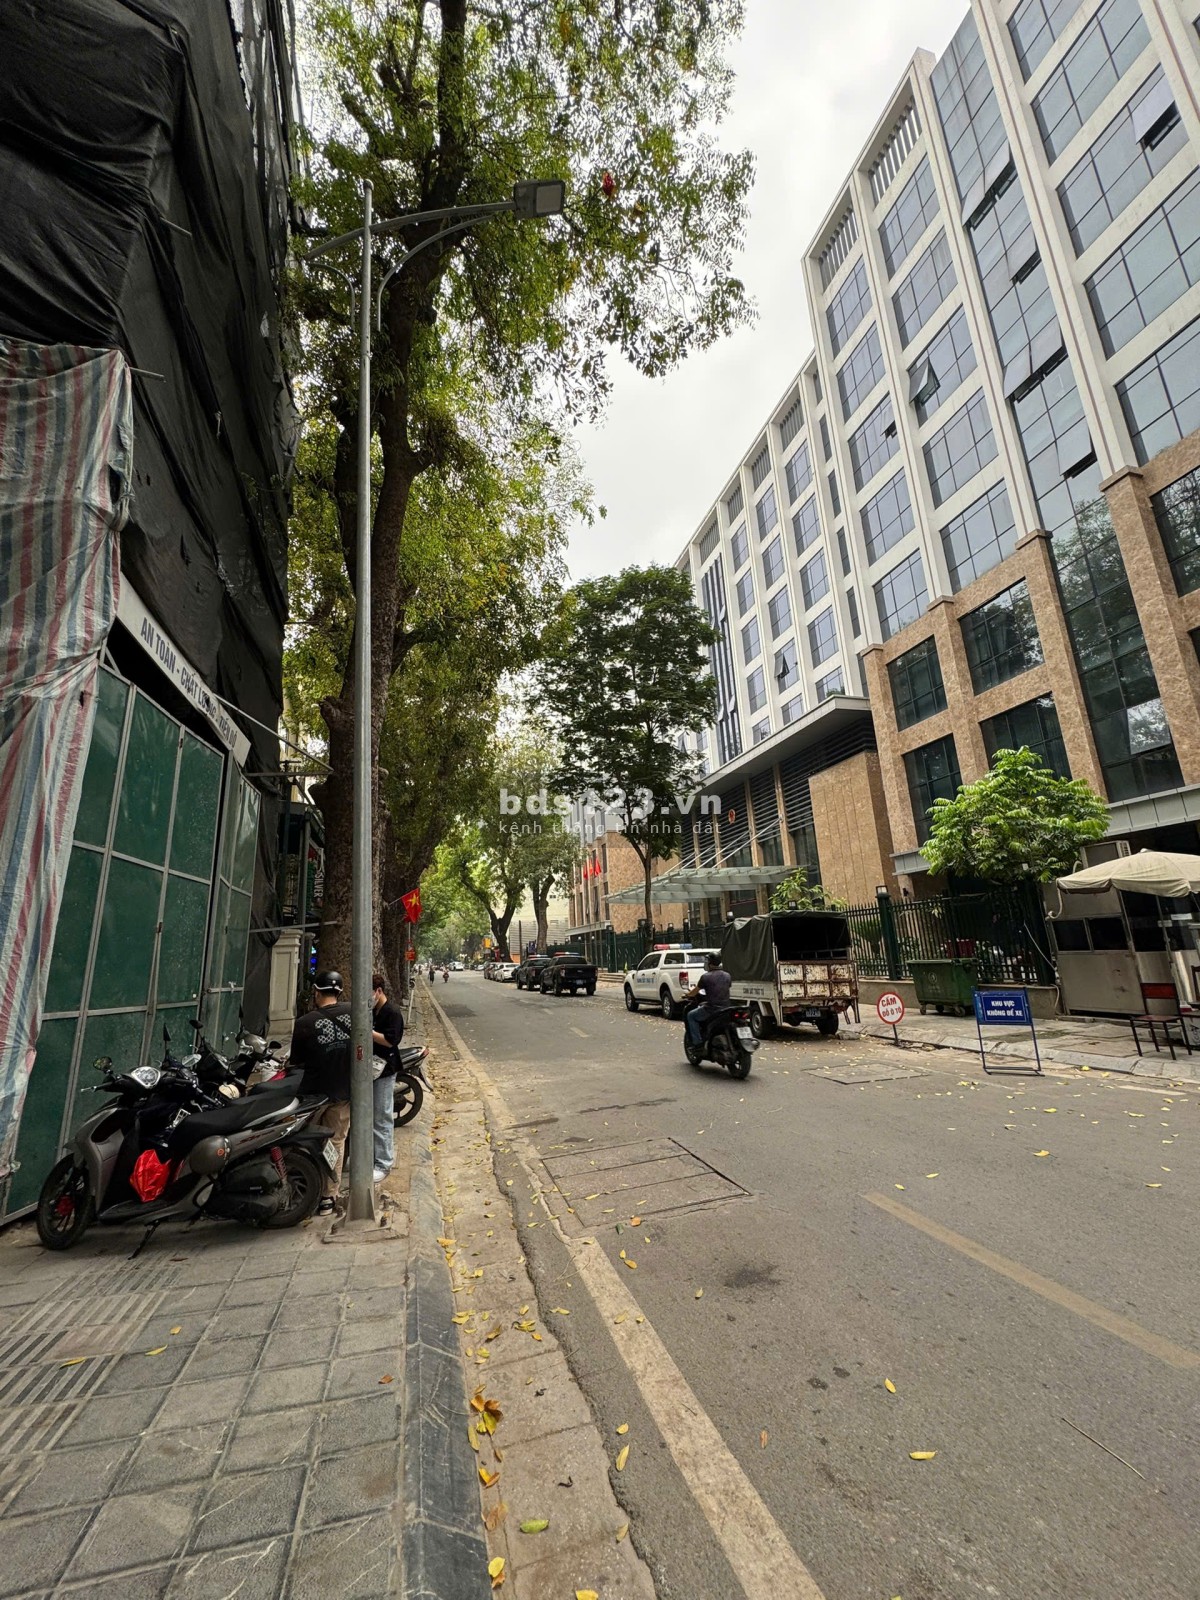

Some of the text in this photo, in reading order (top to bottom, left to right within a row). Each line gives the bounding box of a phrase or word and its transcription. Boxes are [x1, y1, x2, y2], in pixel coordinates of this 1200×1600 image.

[141, 617, 155, 648] AN
[156, 634, 176, 673] TOÀN
[313, 870, 324, 898] SILVER
[881, 996, 897, 1007] CẤM
[986, 1008, 1006, 1016] KHÔNG
